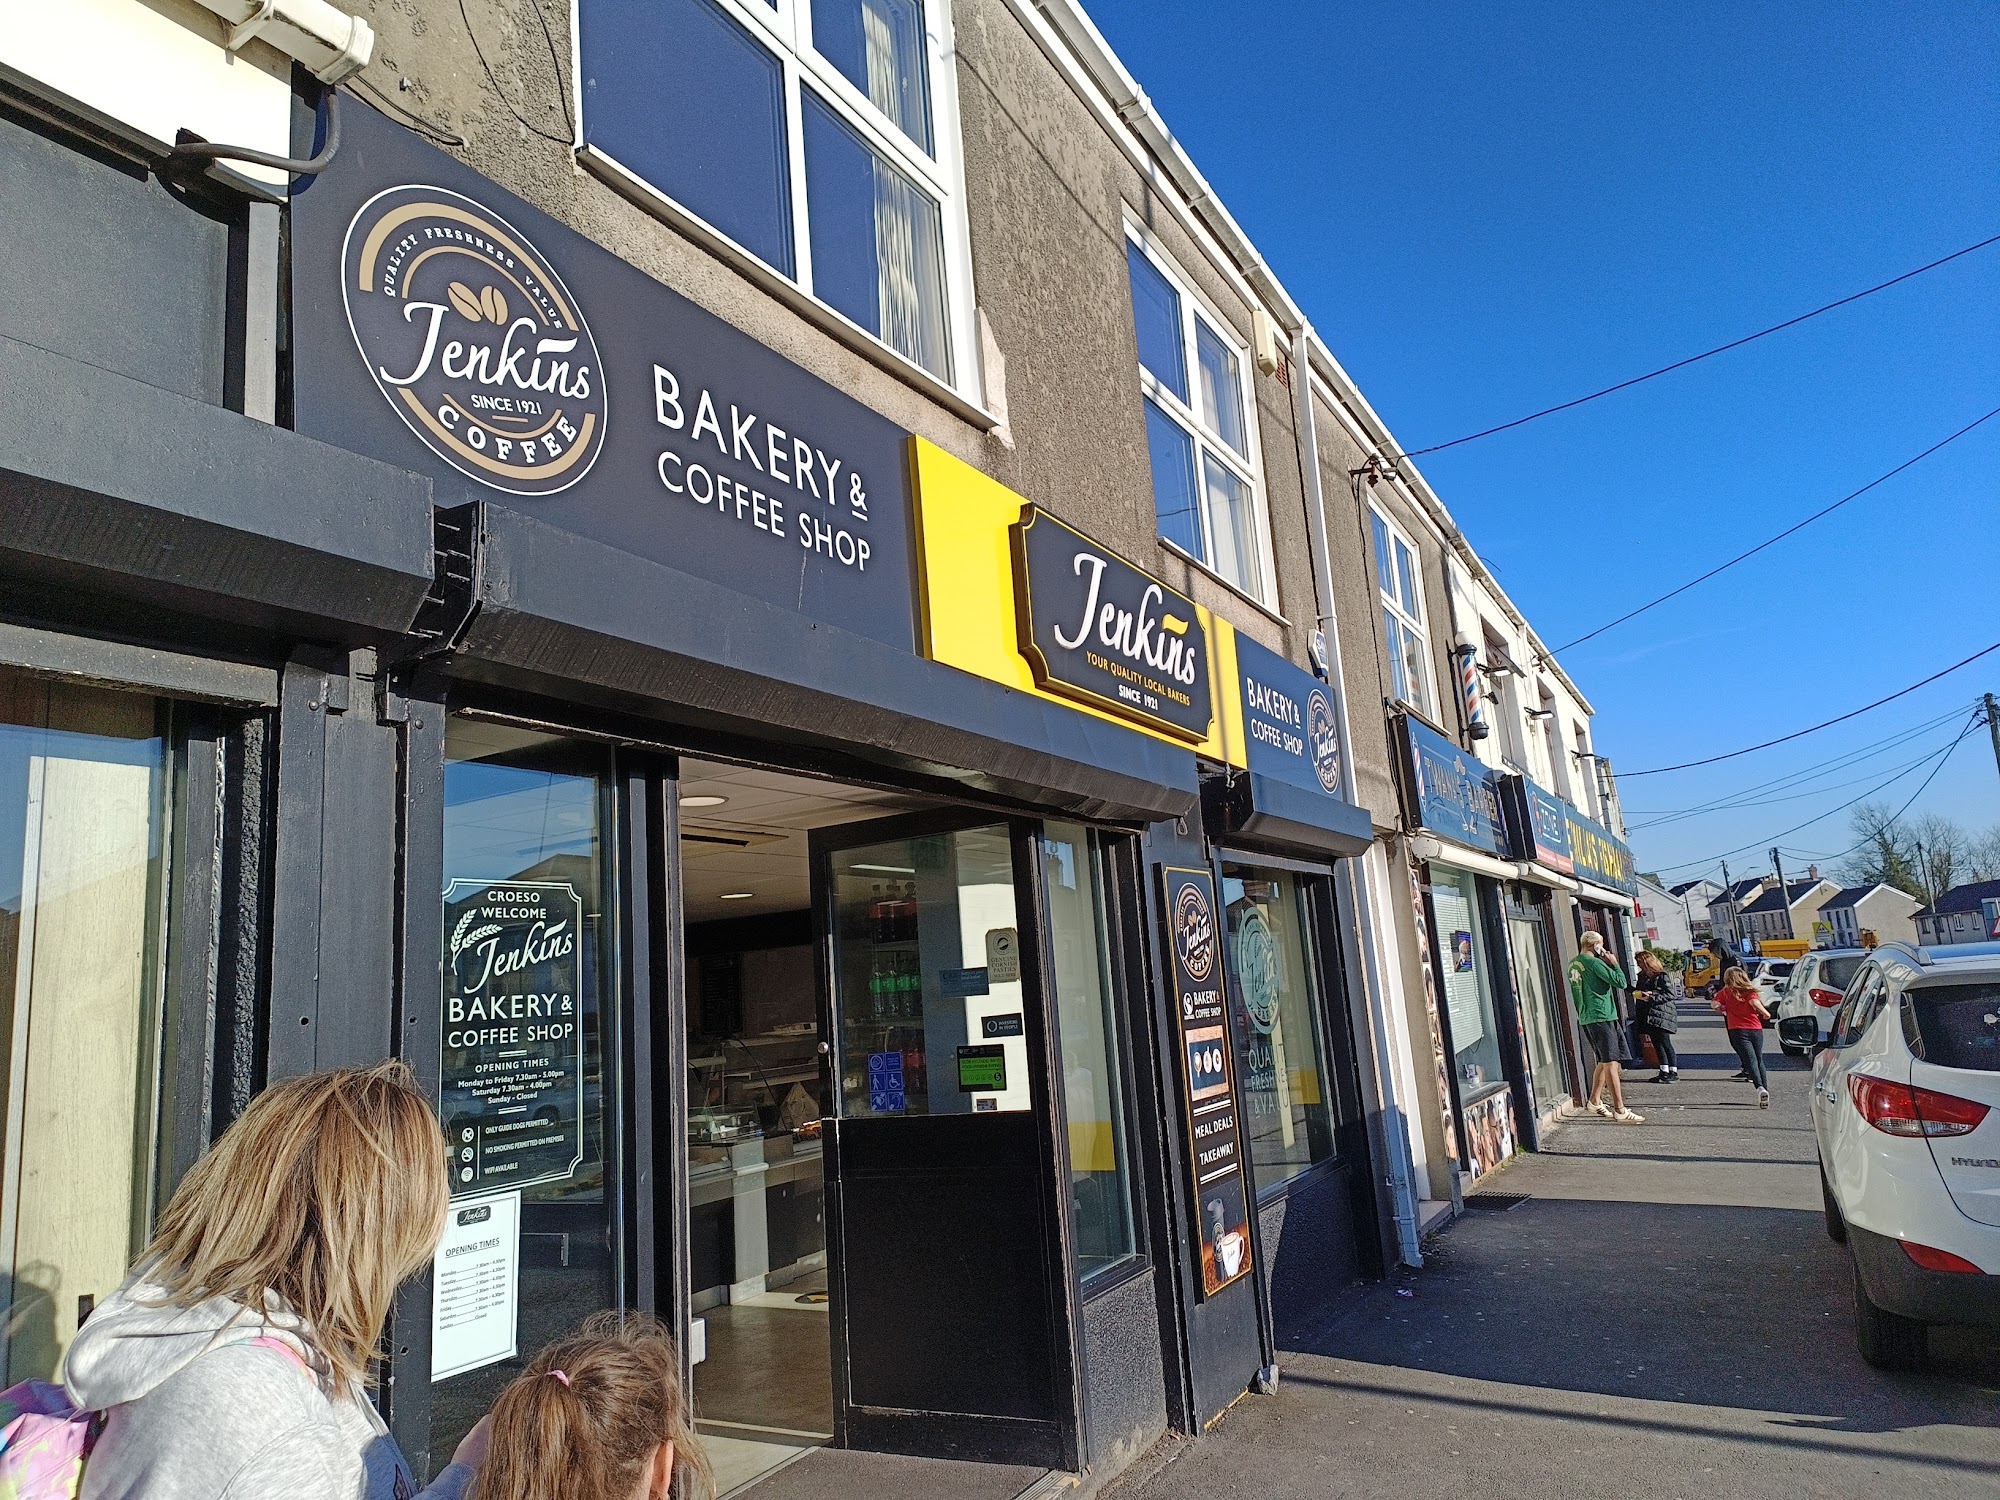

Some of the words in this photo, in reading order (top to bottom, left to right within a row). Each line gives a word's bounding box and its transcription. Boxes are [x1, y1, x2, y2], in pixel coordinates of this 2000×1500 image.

[383, 233, 419, 298] QUALITY
[424, 227, 514, 269] FRESHNESS
[525, 276, 563, 329] VALUE
[379, 301, 590, 400] Jenkins
[471, 395, 512, 412] SINCE
[516, 399, 542, 415] 1921
[438, 404, 578, 464] COFFEE
[653, 363, 842, 506] BAKERY
[849, 472, 868, 520] &
[657, 451, 786, 538] COFFEE
[798, 512, 871, 571] SHOP
[1054, 552, 1195, 685] Jenkins
[1086, 651, 1109, 671] YOUR
[1110, 662, 1142, 685] QUALITY
[1144, 676, 1166, 695] LOCAL
[1167, 688, 1191, 706] BAKERS
[1118, 684, 1141, 704] SINCE
[1143, 694, 1158, 710] 1921
[1246, 677, 1293, 725] BAKERY
[1294, 704, 1301, 729] &
[1251, 718, 1282, 748] COFFEE
[1283, 732, 1303, 757] SHOP
[487, 891, 540, 902] CROESO
[481, 907, 547, 919] WELCOME
[464, 919, 573, 994] Jenkins
[449, 993, 558, 1023] BAKERY
[561, 994, 573, 1015] &
[1193, 990, 1216, 1005] BAKERY
[1195, 1008, 1210, 1018] COFFEE
[1210, 1006, 1221, 1016] SHOP
[448, 1027, 519, 1048] COFFEE
[527, 1023, 574, 1041] SHOP
[475, 1061, 519, 1073] OPENING
[522, 1058, 549, 1068] TIMES
[458, 1079, 484, 1088] Monday
[494, 1075, 514, 1084] Friday
[515, 1073, 538, 1081] 7.30am
[542, 1070, 565, 1079] 5.00pm
[472, 1086, 501, 1097] Saturday
[502, 1084, 525, 1093] 7.30am
[529, 1081, 552, 1090] 4.00pm
[487, 1096, 511, 1104] Sunday
[516, 1091, 538, 1100] Closed
[485, 1125, 498, 1134] ONLY
[498, 1123, 512, 1132] GUIDE
[512, 1122, 526, 1130] DOGS
[1195, 1124, 1213, 1139] MEAL
[1213, 1115, 1233, 1133] DEALS
[493, 1143, 514, 1153] SMOKING
[1199, 1142, 1234, 1165] TAKEAWAY
[445, 1242, 478, 1257] OPENING
[478, 1237, 500, 1249] TIMES
